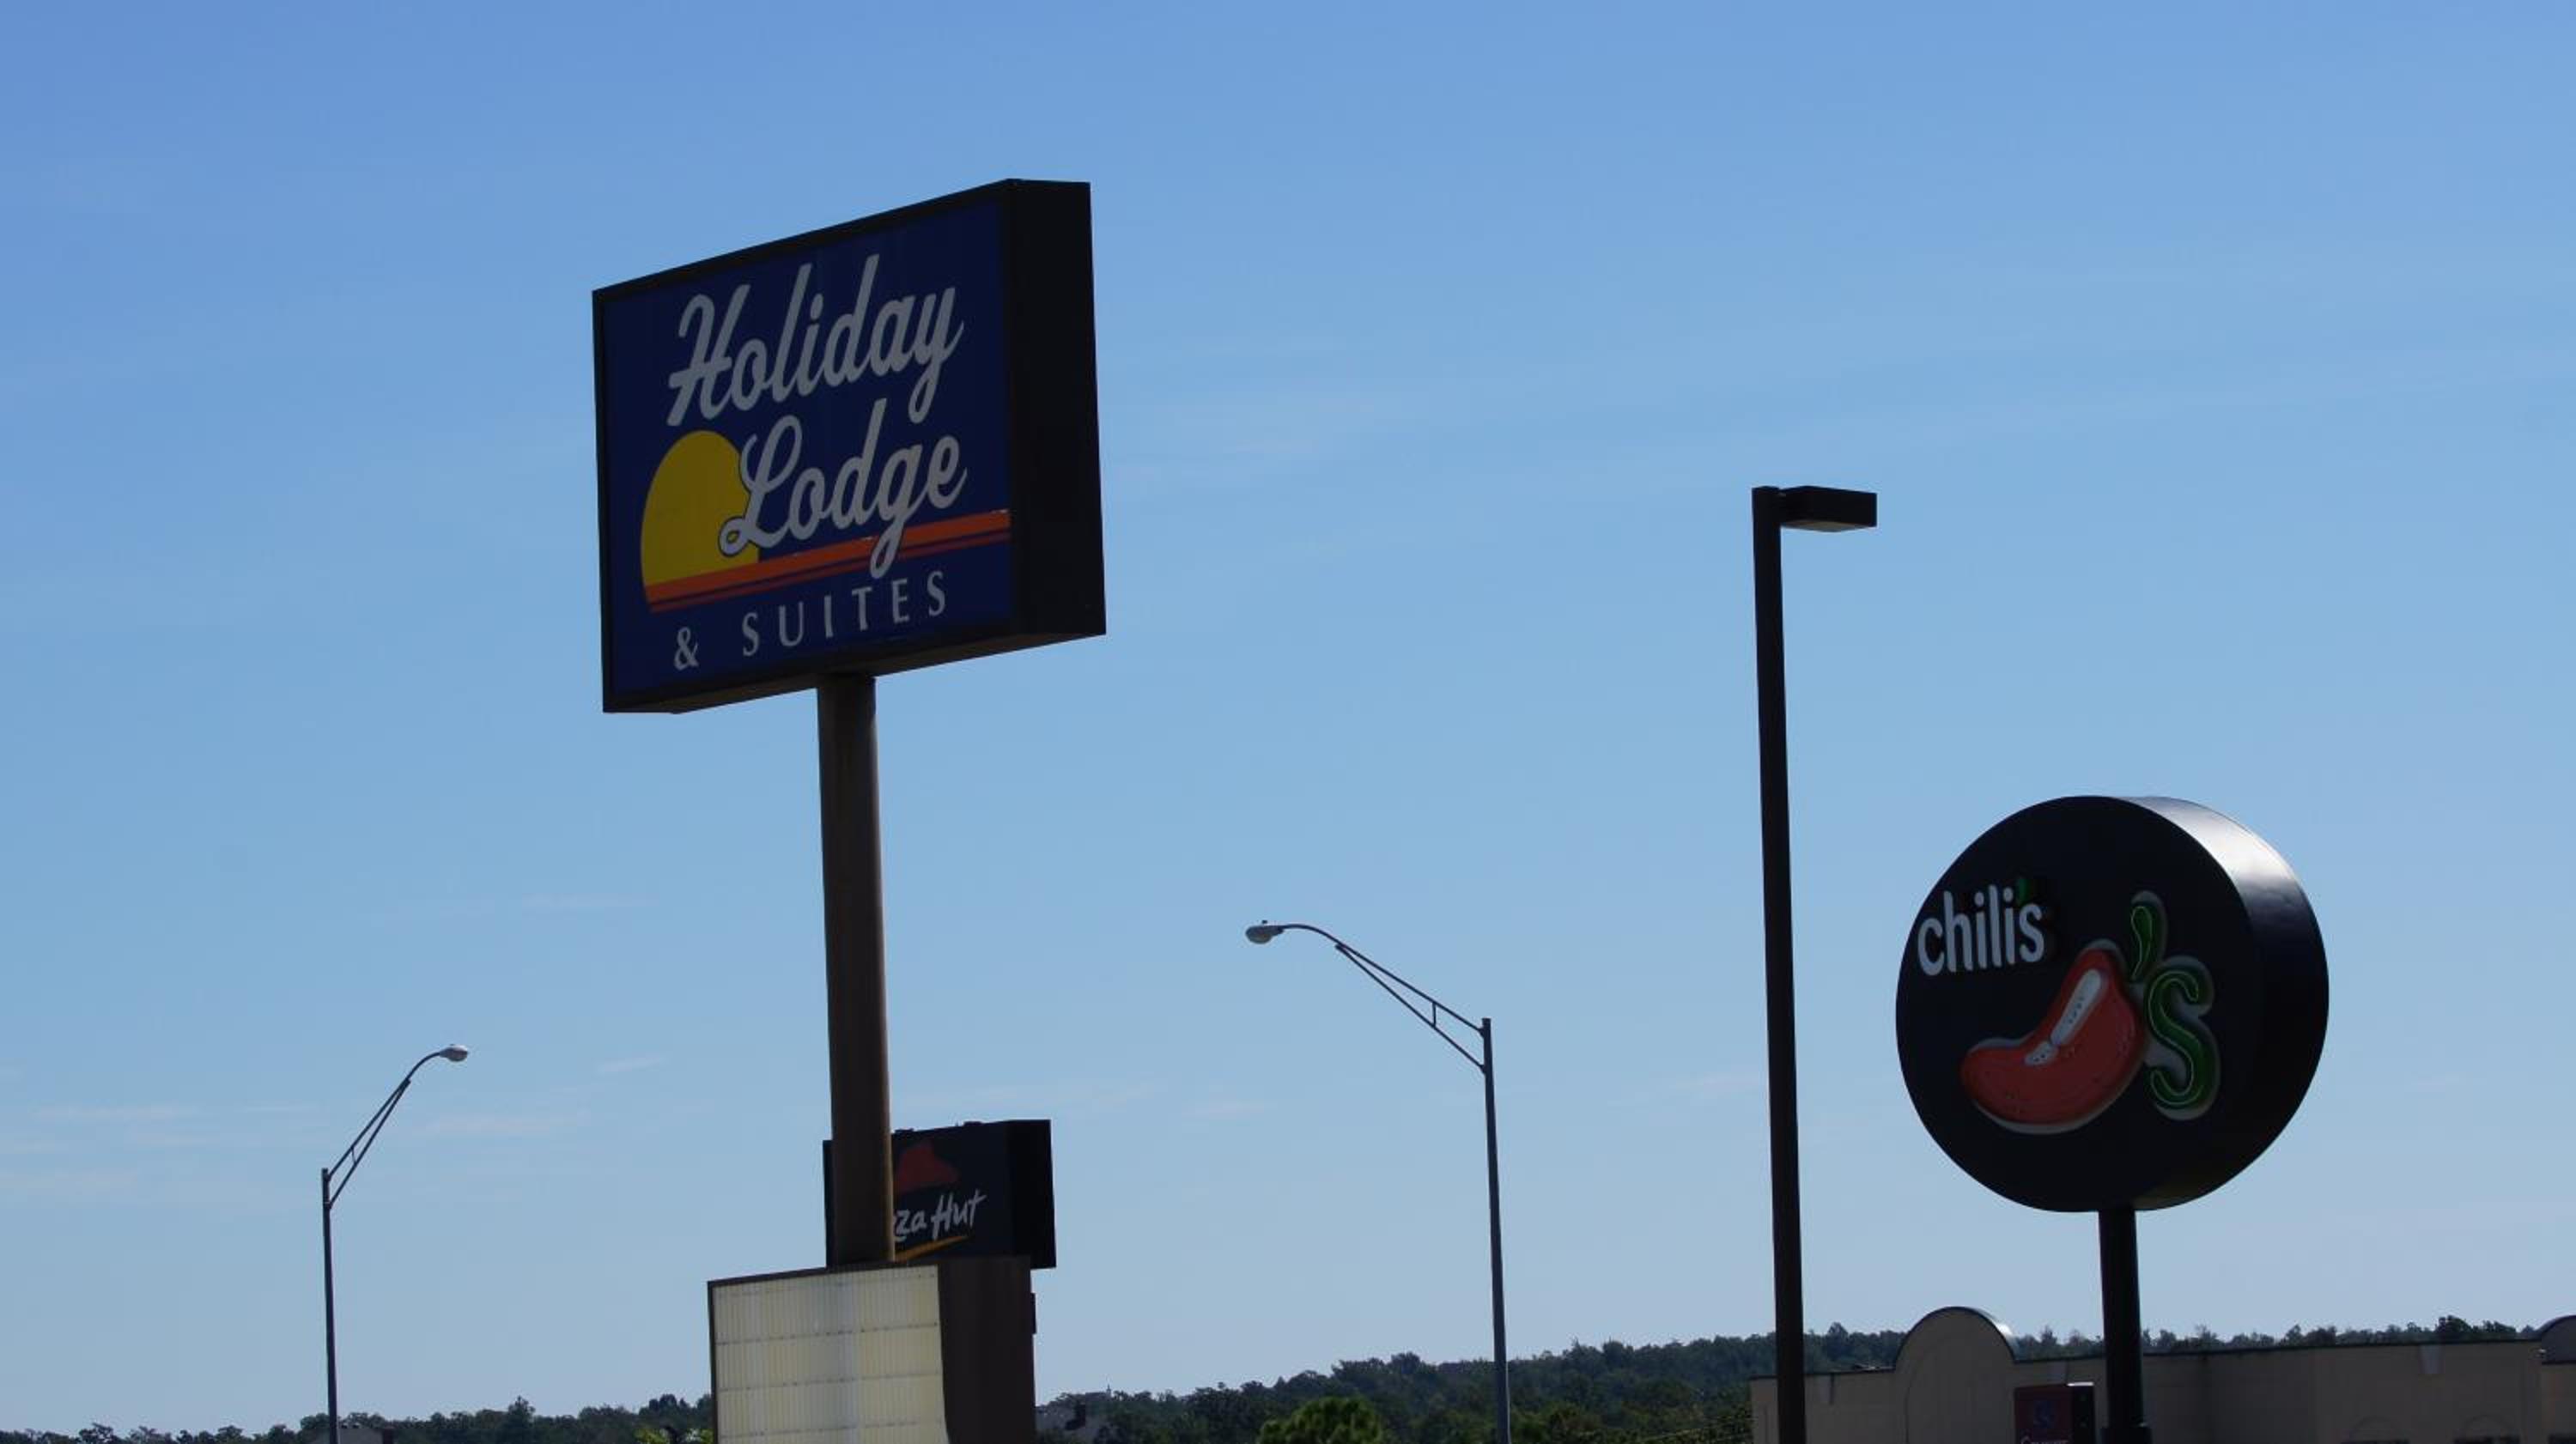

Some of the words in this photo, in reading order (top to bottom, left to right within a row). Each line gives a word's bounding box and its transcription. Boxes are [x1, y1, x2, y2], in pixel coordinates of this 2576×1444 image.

[666, 254, 964, 427] Holiday
[718, 397, 967, 579] Lodge
[673, 627, 699, 670] &
[742, 570, 946, 657] SUITES
[931, 1188, 987, 1241] Hut
